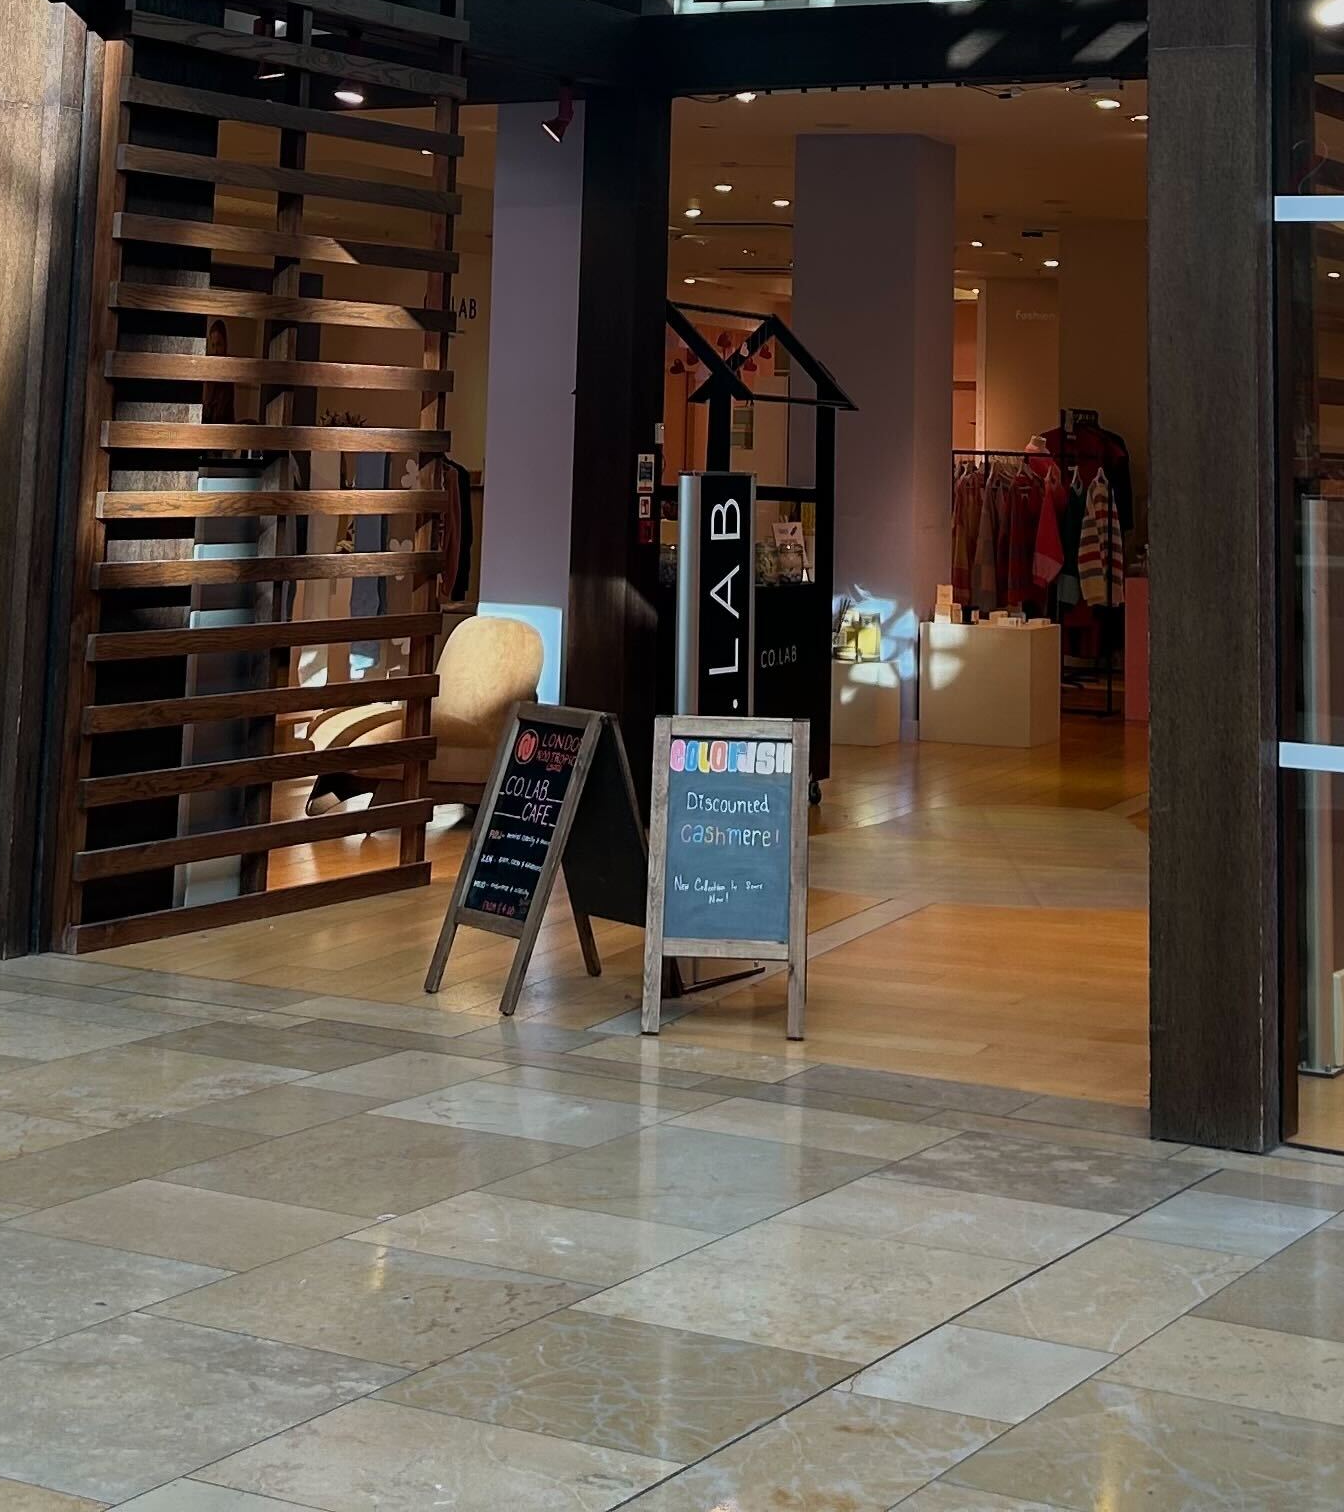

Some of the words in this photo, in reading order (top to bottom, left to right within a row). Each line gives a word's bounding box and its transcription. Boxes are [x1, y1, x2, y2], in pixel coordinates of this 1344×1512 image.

[761, 646, 797, 669] CO.LAB
[506, 776, 549, 801] CO.LAB
[521, 803, 553, 825] CAFE
[686, 791, 770, 814] Discounted
